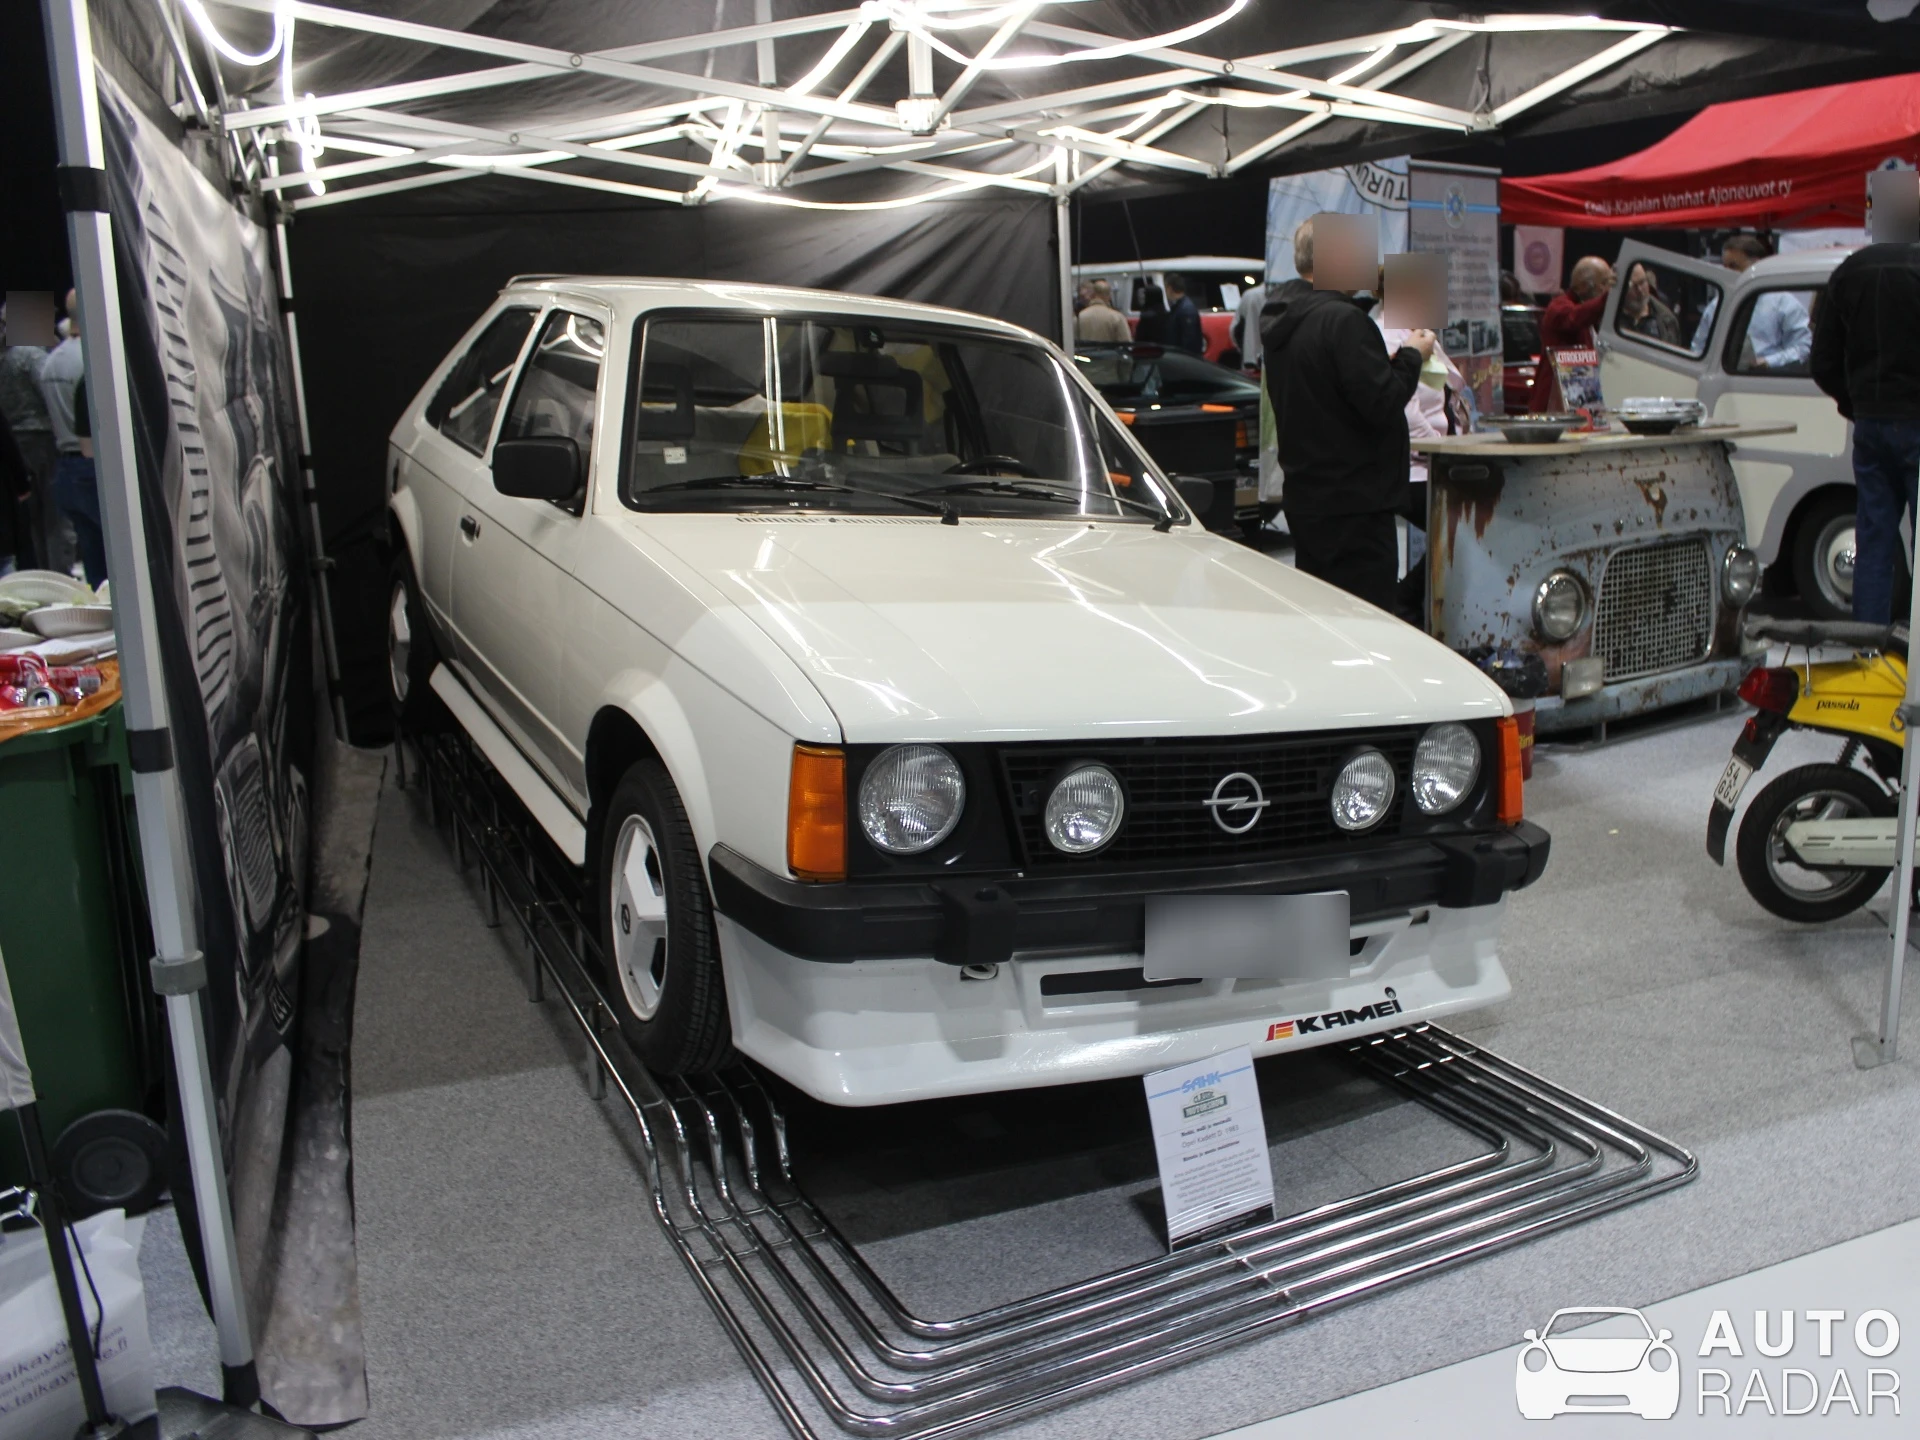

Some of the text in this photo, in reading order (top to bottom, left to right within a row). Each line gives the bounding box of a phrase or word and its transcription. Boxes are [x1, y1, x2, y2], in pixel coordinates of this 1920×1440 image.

[1663, 189, 1705, 209] Vanhat
[1708, 182, 1775, 208] Ajoneuvot
[1779, 179, 1792, 197] ry
[1816, 699, 1860, 712] passola
[1296, 1000, 1402, 1035] KAMEI
[1181, 1071, 1221, 1094] SAHK
